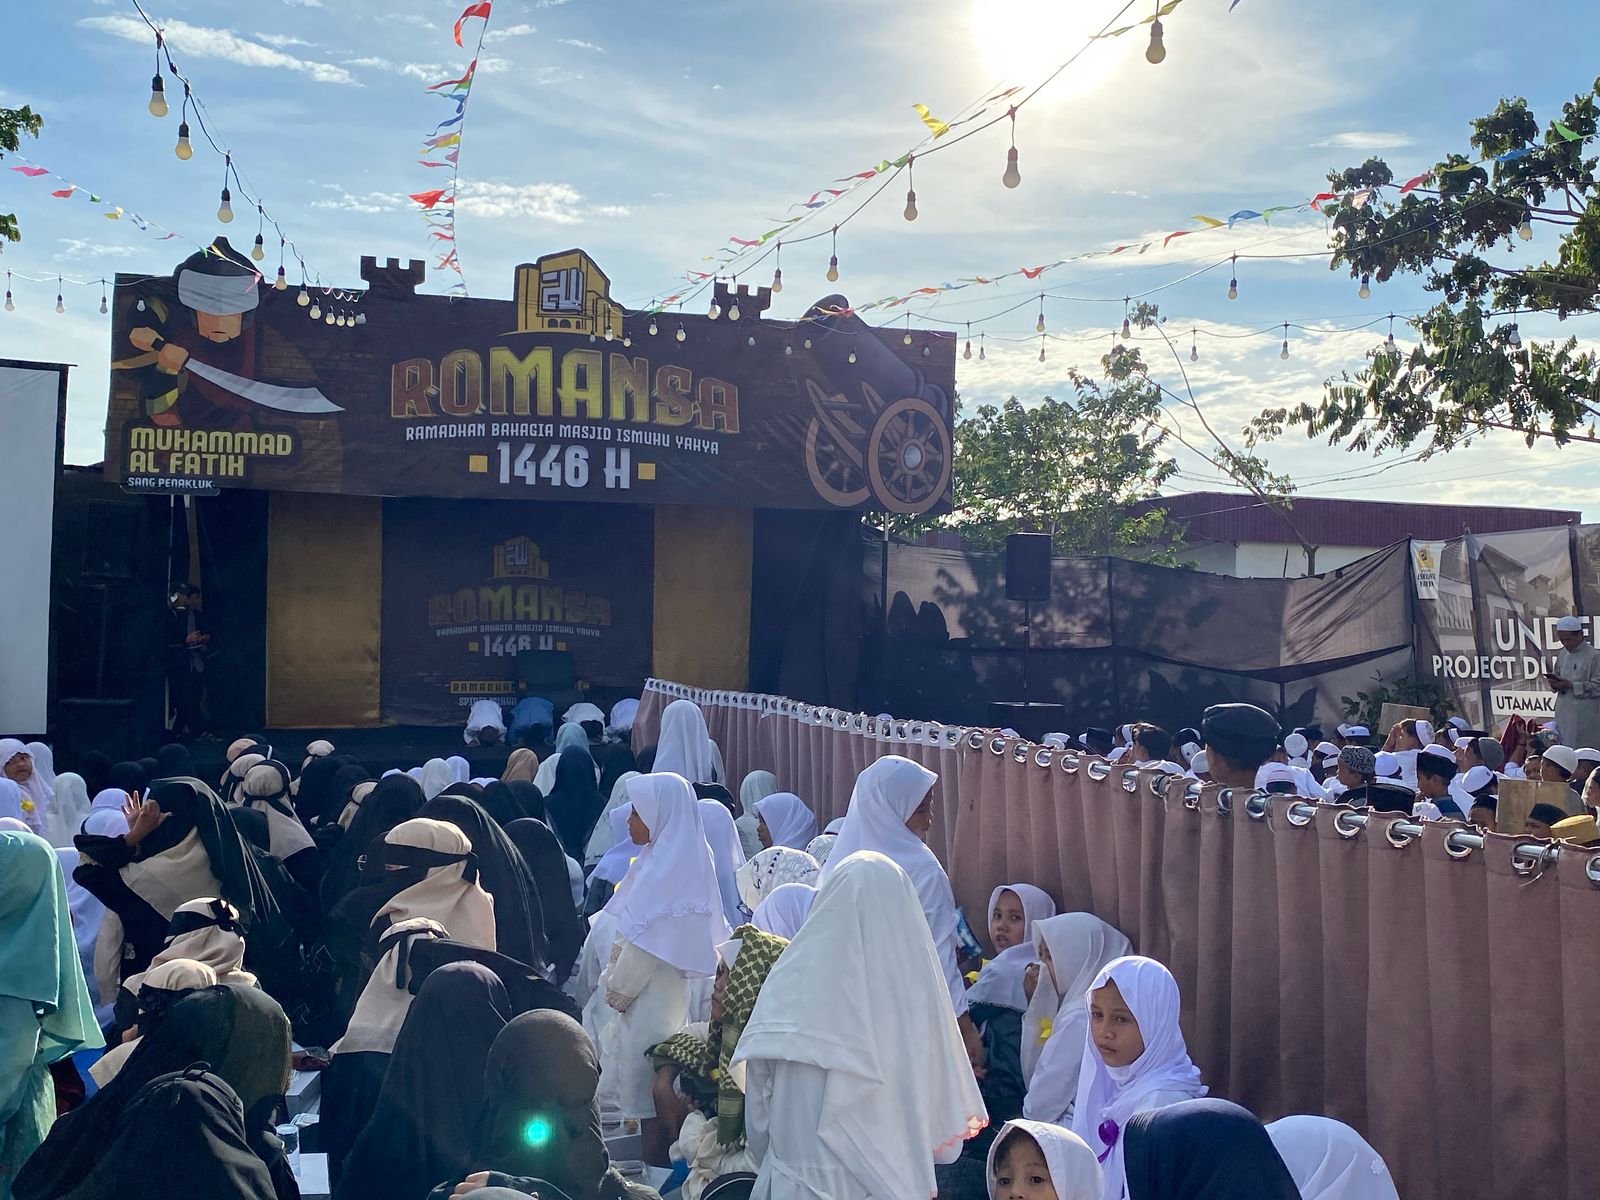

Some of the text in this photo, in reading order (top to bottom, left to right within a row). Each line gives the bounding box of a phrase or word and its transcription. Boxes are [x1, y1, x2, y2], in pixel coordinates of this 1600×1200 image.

[391, 346, 740, 433] ROMANSA
[130, 427, 293, 456] MUHAMMAD
[406, 423, 719, 455] RAMADHAN BAHAGIA MASJID ISMUHU YAHYA
[129, 451, 245, 477] AL FATIH
[497, 441, 631, 489] 1446 H
[127, 476, 213, 490] SANG PENAKLUK
[428, 584, 611, 625] ROMANSA
[436, 626, 477, 637] RAMADHAN
[1495, 615, 1600, 651] UNDE
[484, 634, 531, 657] 1446
[1432, 655, 1516, 679] PROJECT
[1496, 695, 1555, 712] UTAMAK
